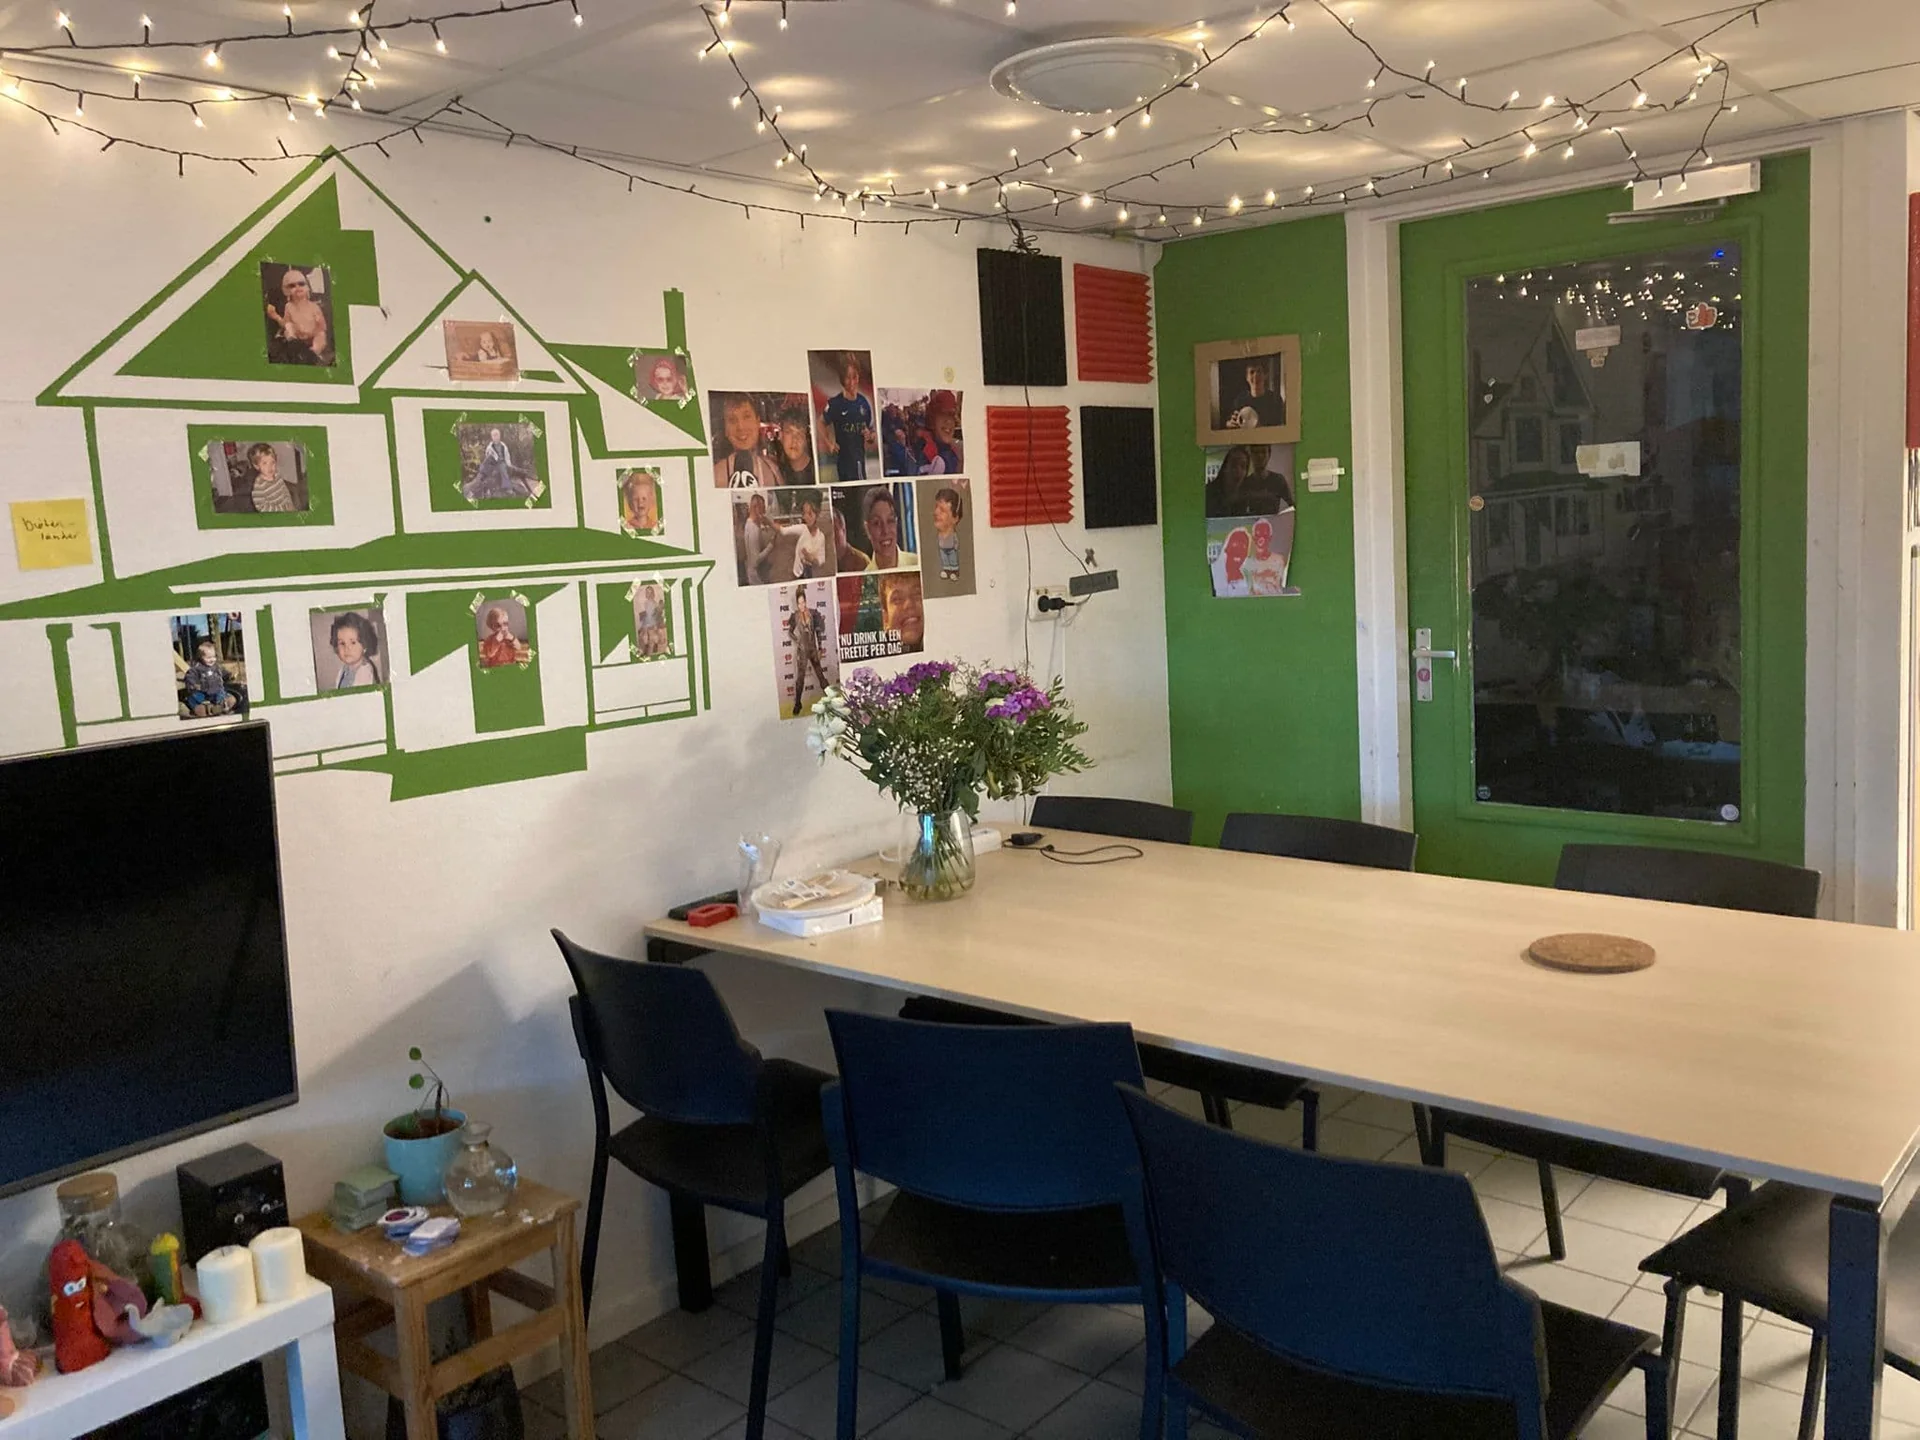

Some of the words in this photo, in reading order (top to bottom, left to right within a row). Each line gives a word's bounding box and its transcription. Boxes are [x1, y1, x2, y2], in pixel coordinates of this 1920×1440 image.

[853, 630, 878, 645] DRINK
[878, 629, 888, 642] IK
[888, 629, 902, 641] EEN
[870, 642, 886, 657] PER
